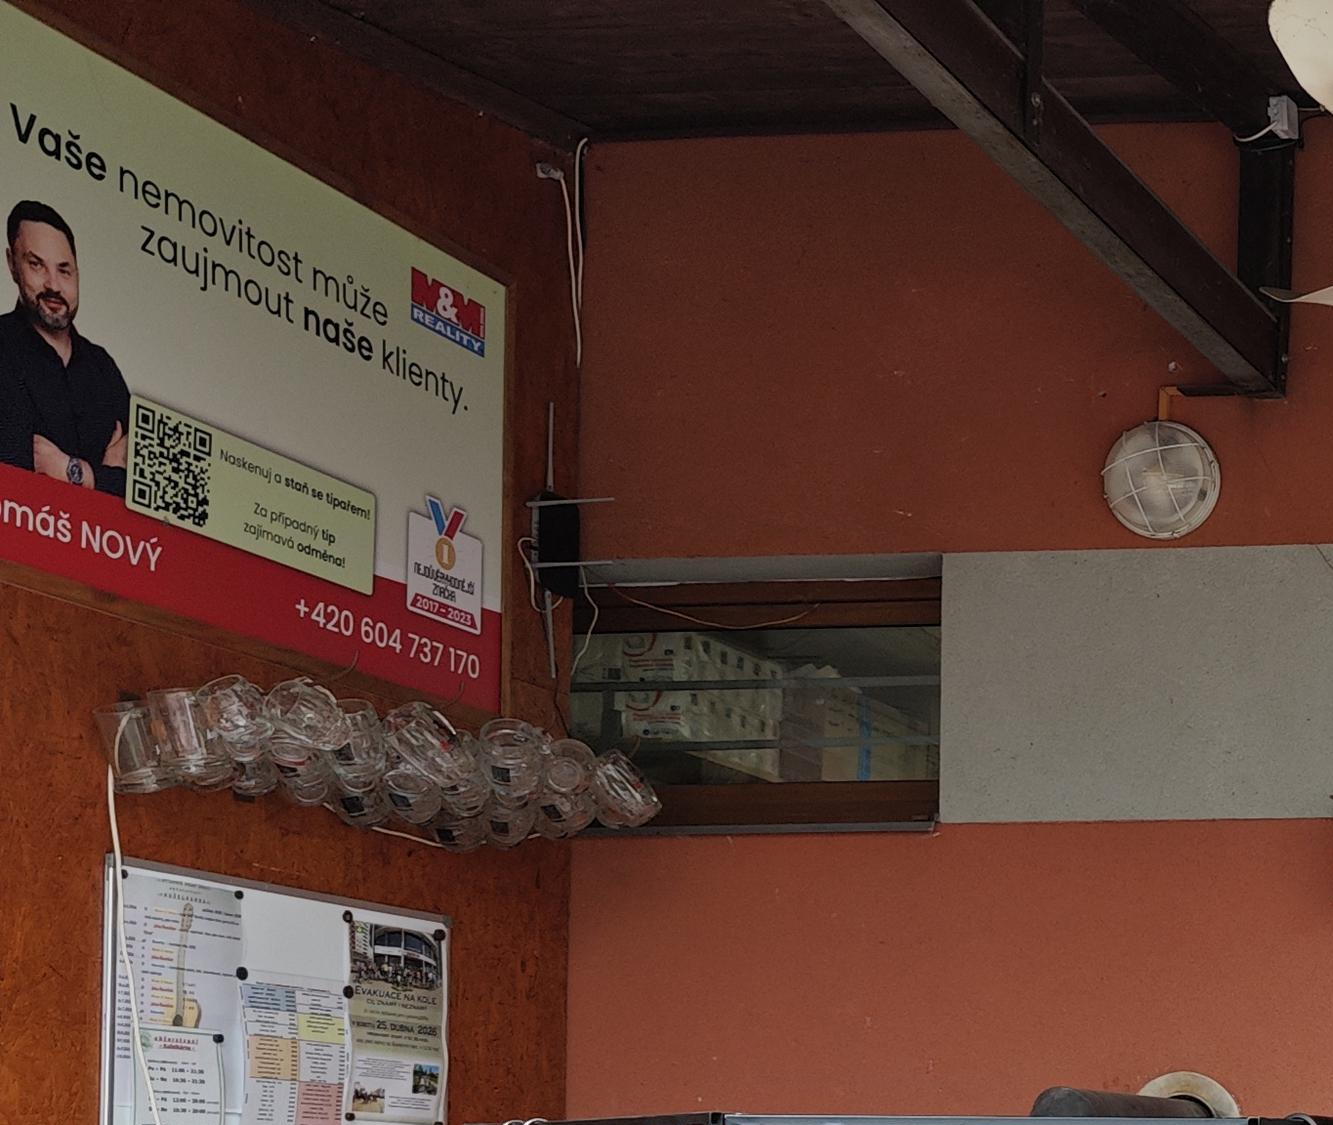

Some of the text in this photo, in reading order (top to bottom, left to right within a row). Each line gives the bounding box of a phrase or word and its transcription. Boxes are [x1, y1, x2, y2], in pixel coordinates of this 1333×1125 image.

[9, 102, 388, 326] Vaše nemovitost může
[140, 225, 468, 415] zaujmout naše klienty.
[412, 306, 482, 352] REALITY
[220, 449, 370, 520] Naskenuj a staň se tipařem!
[0, 500, 162, 571] máš NOVÝ
[243, 522, 345, 568] zajímavá odměna!
[254, 502, 336, 545] Za případný tip
[295, 599, 479, 678] +420 604 737 170
[416, 596, 471, 626] 2017 2023
[355, 986, 402, 1000] EVAKUACE
